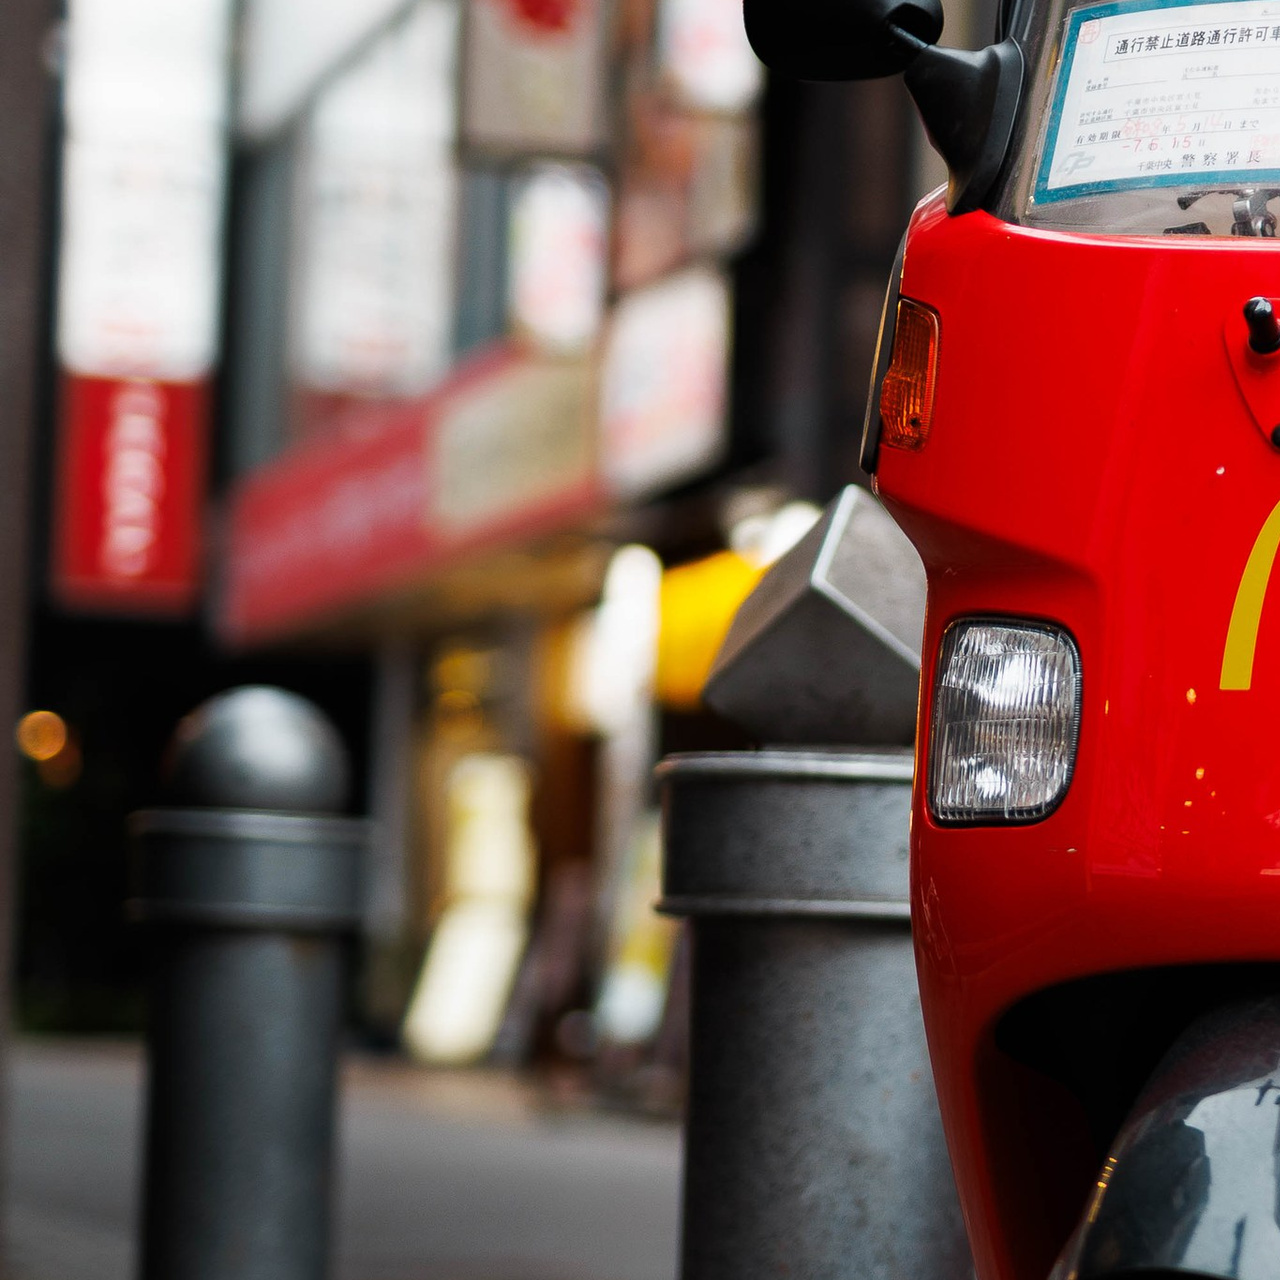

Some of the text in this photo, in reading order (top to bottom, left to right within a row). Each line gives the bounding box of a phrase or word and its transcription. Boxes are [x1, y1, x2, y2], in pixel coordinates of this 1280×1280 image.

[1076, 131, 1122, 145] 有効期限
[1181, 150, 1261, 169] 警察署長
